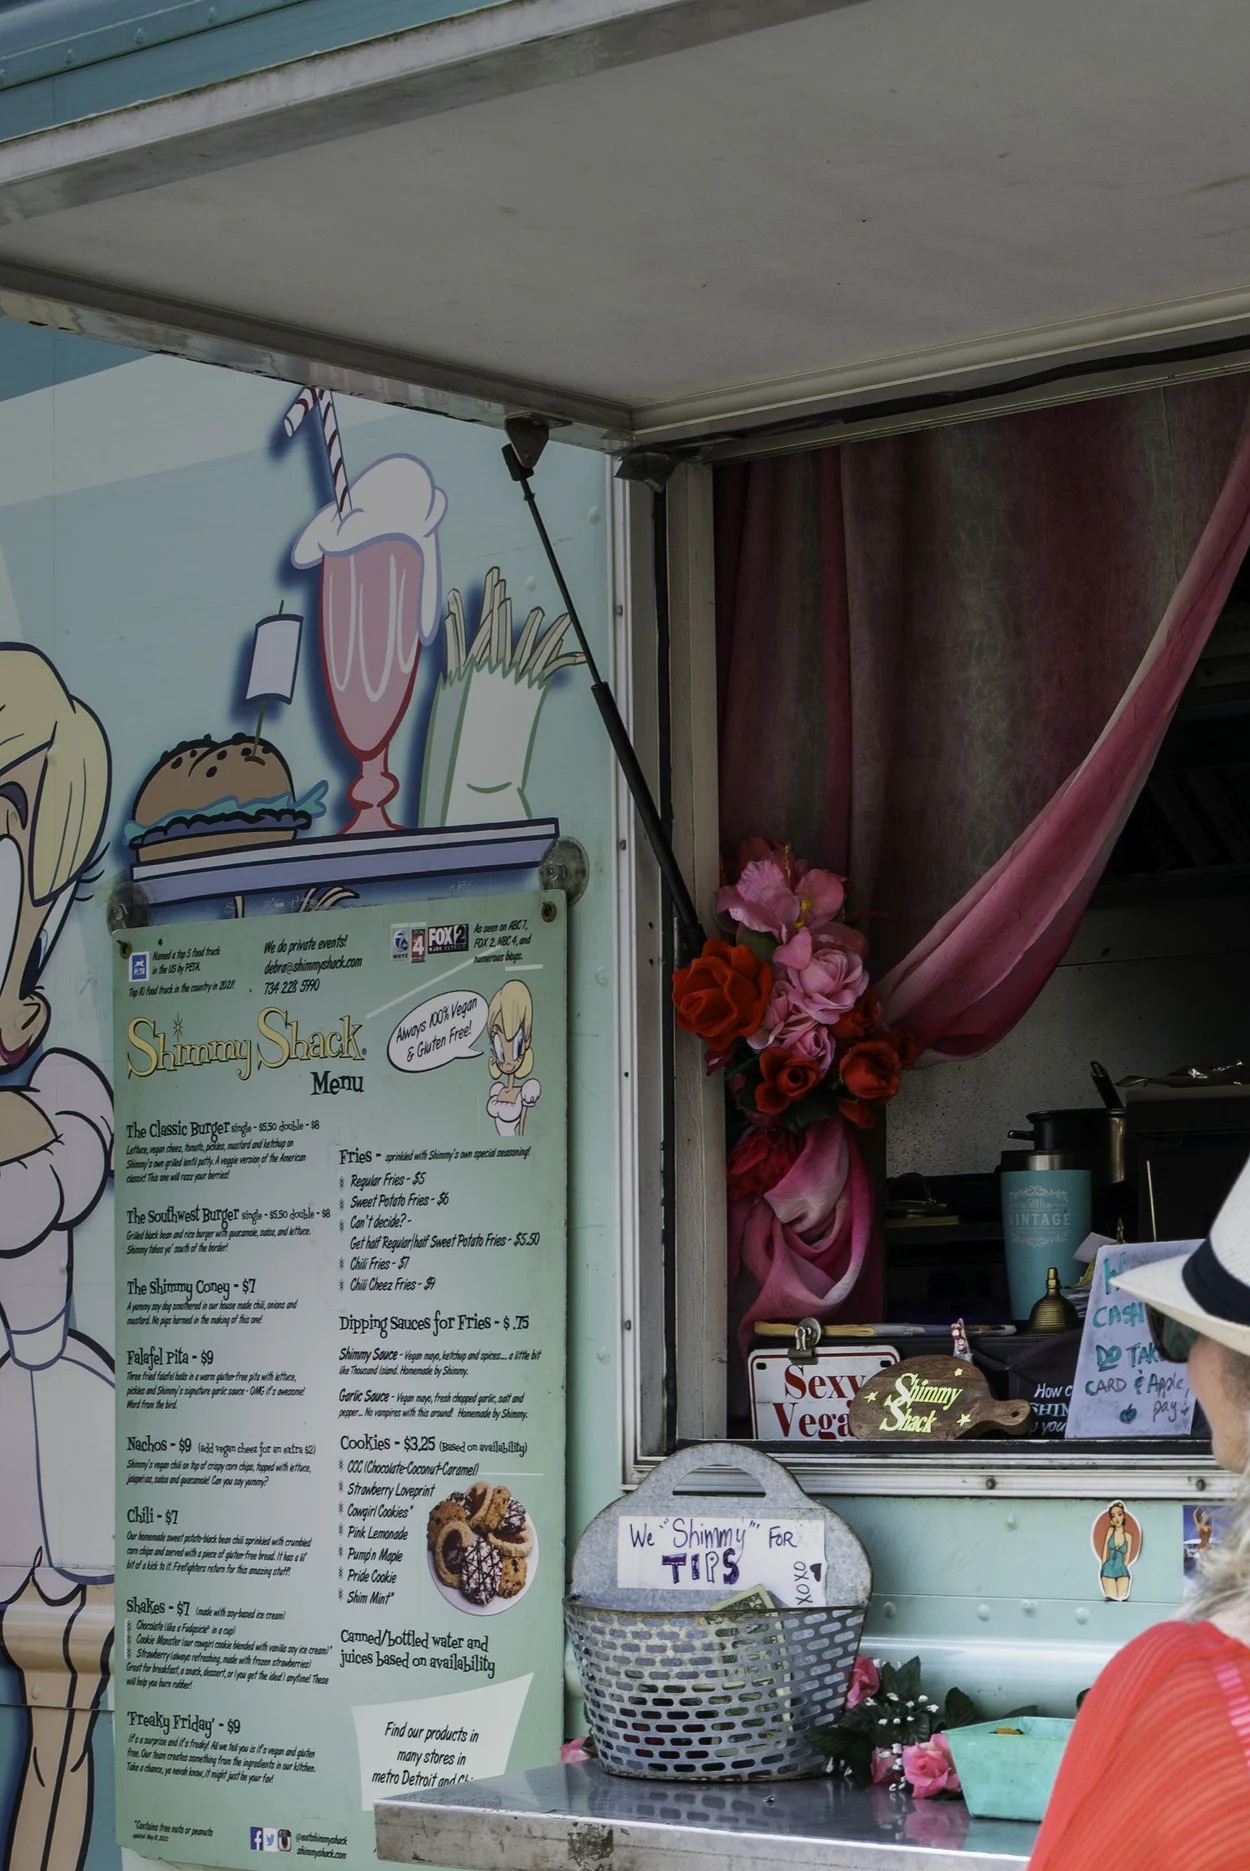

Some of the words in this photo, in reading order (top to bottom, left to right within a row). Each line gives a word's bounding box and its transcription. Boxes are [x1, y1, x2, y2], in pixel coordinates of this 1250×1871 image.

[474, 924, 482, 933] As
[483, 925, 498, 933] seen
[508, 920, 522, 930] ABC
[264, 940, 276, 954] We
[277, 938, 287, 953] do
[287, 937, 315, 955] private
[318, 934, 348, 950] events!
[429, 927, 453, 946] FOX
[456, 926, 466, 944] 2
[474, 938, 489, 948] FOX
[519, 934, 532, 945] and
[413, 936, 424, 955] 4
[264, 955, 362, 974] debra@shimmyshack.com
[474, 954, 504, 963] numerous
[264, 982, 280, 995] 734
[300, 978, 320, 992] 5990
[396, 1021, 426, 1042] Always
[429, 1006, 449, 1028] 100%
[452, 998, 477, 1018] Vegan
[128, 1016, 251, 1081] Shimmy
[257, 1007, 363, 1070] Shack
[407, 1046, 414, 1062] &
[416, 1034, 446, 1057] Gluten
[449, 1020, 472, 1043] Free!
[310, 1071, 364, 1095] Menu
[126, 1122, 146, 1138] The
[149, 1120, 188, 1138] Classic
[190, 1122, 230, 1145] Burger
[231, 1122, 252, 1138] single
[279, 1119, 304, 1132] double
[311, 1120, 320, 1130] $8
[339, 1147, 372, 1164] Fries
[350, 1174, 382, 1191] Regular
[383, 1172, 405, 1186] Fries
[412, 1171, 426, 1186] $5
[350, 1194, 378, 1208] Sweet
[378, 1194, 406, 1207] Potato
[408, 1193, 430, 1206] Fries
[437, 1192, 449, 1206] $6
[127, 1207, 146, 1224] The
[148, 1204, 200, 1223] Southwest
[202, 1208, 240, 1231] Burger
[242, 1209, 262, 1225] single
[290, 1207, 314, 1220] double
[322, 1208, 330, 1218] $8
[350, 1215, 374, 1229] Can't
[374, 1213, 406, 1228] decide?
[1008, 1213, 1071, 1226] VINTAGE
[350, 1256, 368, 1270] Chili
[369, 1256, 390, 1270] Fries
[398, 1256, 410, 1270] $7
[127, 1278, 147, 1295] The
[150, 1278, 193, 1303] Shimmy
[196, 1280, 230, 1301] Coney
[242, 1278, 256, 1294] $7
[350, 1277, 368, 1291] Chili
[369, 1277, 393, 1291] Cheez
[395, 1277, 416, 1290] Fries
[424, 1276, 436, 1290] $9
[339, 1314, 388, 1339] Dipping
[390, 1316, 430, 1330] Sauces
[433, 1310, 455, 1336] for
[457, 1313, 491, 1330] Fries
[1093, 1303, 1145, 1328] CASH
[126, 1346, 163, 1371] Falafel
[166, 1347, 189, 1364] Pita
[201, 1350, 214, 1366] $9
[339, 1346, 372, 1364] Shimmy
[372, 1348, 398, 1360] Sauce
[1096, 1344, 1122, 1365] DO
[1126, 1343, 1167, 1368] TAK
[339, 1388, 363, 1402] Garlic
[364, 1390, 390, 1402] Sauce
[886, 1372, 963, 1410] Shimmy
[1034, 1383, 1063, 1398] How
[1085, 1378, 1127, 1396] CARD
[773, 1402, 851, 1440] Vega
[879, 1399, 937, 1433] Shack
[126, 1435, 167, 1452] Nachos
[179, 1438, 192, 1454] $9
[340, 1434, 390, 1451] Cookies
[347, 1460, 364, 1473] CCC
[348, 1482, 394, 1500] Strawberry
[395, 1483, 436, 1500] Loveprint
[127, 1506, 154, 1524] Chili
[166, 1510, 178, 1525] $7
[347, 1503, 378, 1521] Cowgirl
[348, 1526, 366, 1538] Pink
[368, 1526, 408, 1540] Lemonade
[630, 1524, 654, 1547] We
[378, 1548, 403, 1564] Maple
[662, 1548, 741, 1585] TIPS
[347, 1568, 370, 1582] Pride
[371, 1569, 397, 1584] Cookie
[126, 1596, 165, 1614] Shakes
[177, 1601, 190, 1616] $7
[347, 1590, 368, 1604] Shim
[341, 1629, 429, 1649] Canned/bottled
[431, 1632, 464, 1649] water
[467, 1635, 488, 1652] and
[340, 1649, 373, 1668] juices
[376, 1651, 410, 1668] based
[412, 1657, 427, 1666] on
[430, 1654, 495, 1679] availability
[228, 1718, 240, 1734] $9
[385, 1722, 408, 1737] Find
[407, 1728, 424, 1738] our
[424, 1725, 468, 1743] products
[470, 1733, 479, 1742] in
[397, 1751, 422, 1766] many
[424, 1749, 455, 1765] stores
[457, 1752, 466, 1765] in
[372, 1769, 399, 1784] metro
[402, 1770, 438, 1786] Detroit
[296, 1832, 347, 1846] @eatshimmyshack
[297, 1846, 346, 1859] shimmyshack.com
